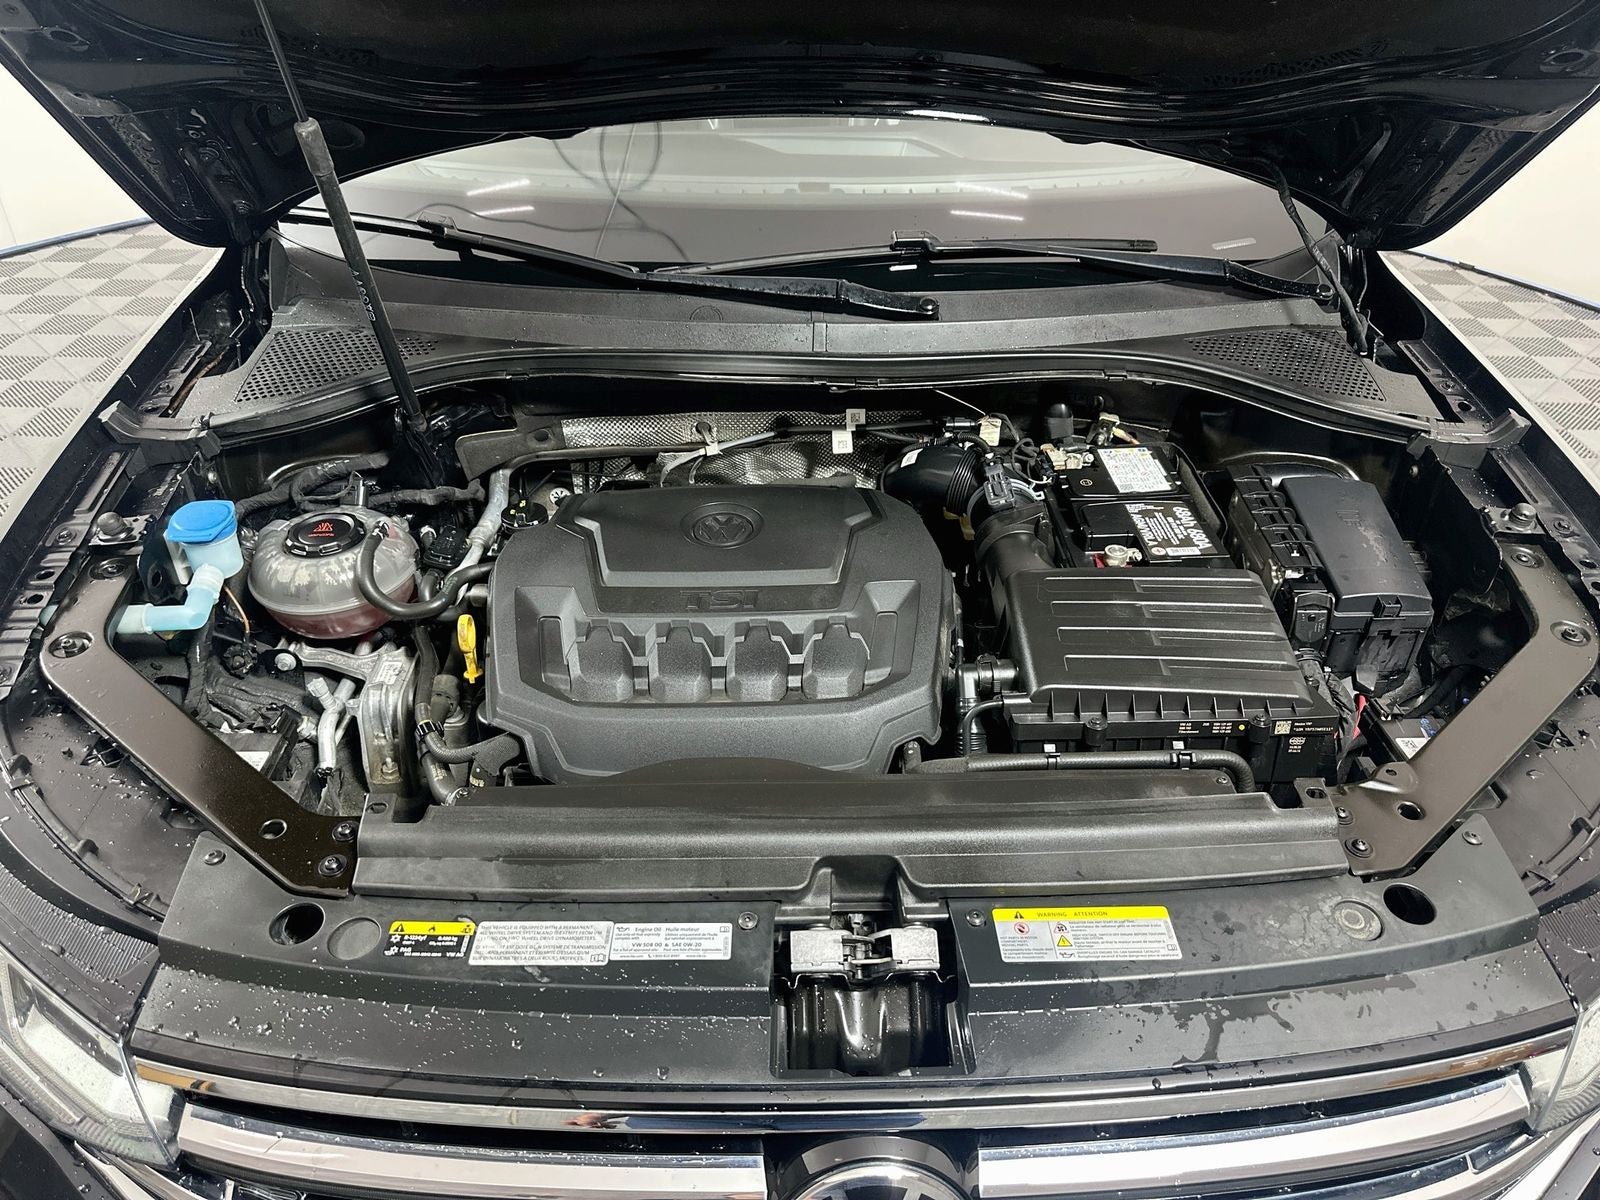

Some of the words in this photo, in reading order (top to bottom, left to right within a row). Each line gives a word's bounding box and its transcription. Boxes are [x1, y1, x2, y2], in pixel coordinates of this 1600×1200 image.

[1172, 506, 1197, 527] 68Ah
[1186, 528, 1212, 549] 680A
[680, 590, 758, 609] TSI
